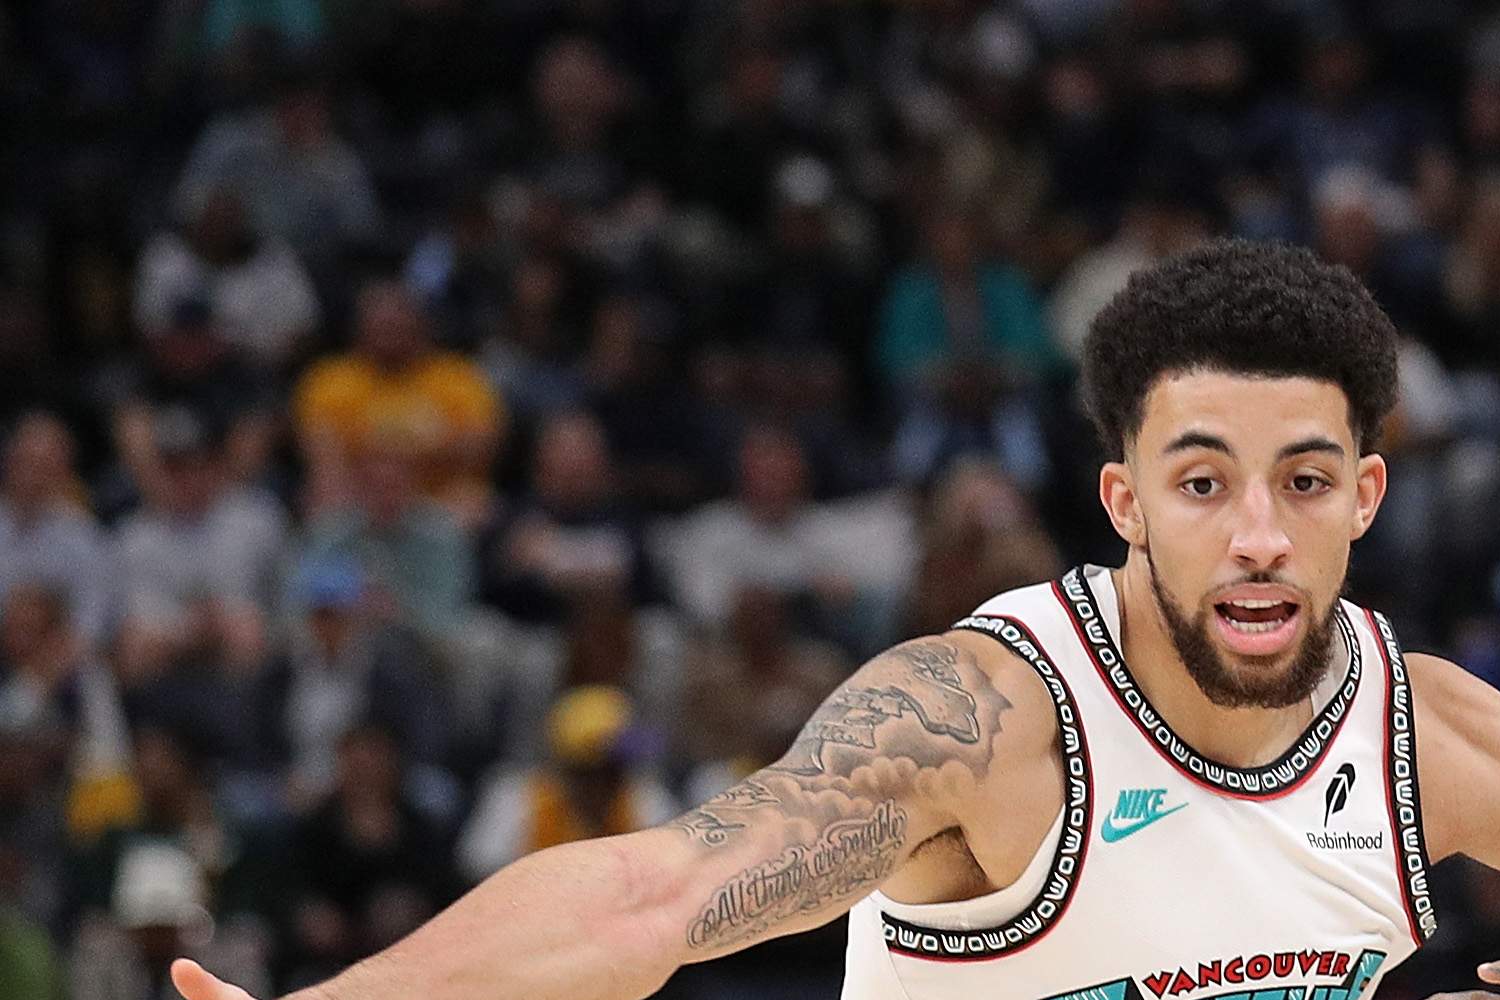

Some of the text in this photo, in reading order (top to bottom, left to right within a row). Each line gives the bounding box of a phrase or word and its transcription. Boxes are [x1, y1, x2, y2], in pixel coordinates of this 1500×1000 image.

[1112, 788, 1168, 820] NIKE
[1306, 831, 1384, 850] Robinhood
[1142, 948, 1352, 999] VANCOUVER
